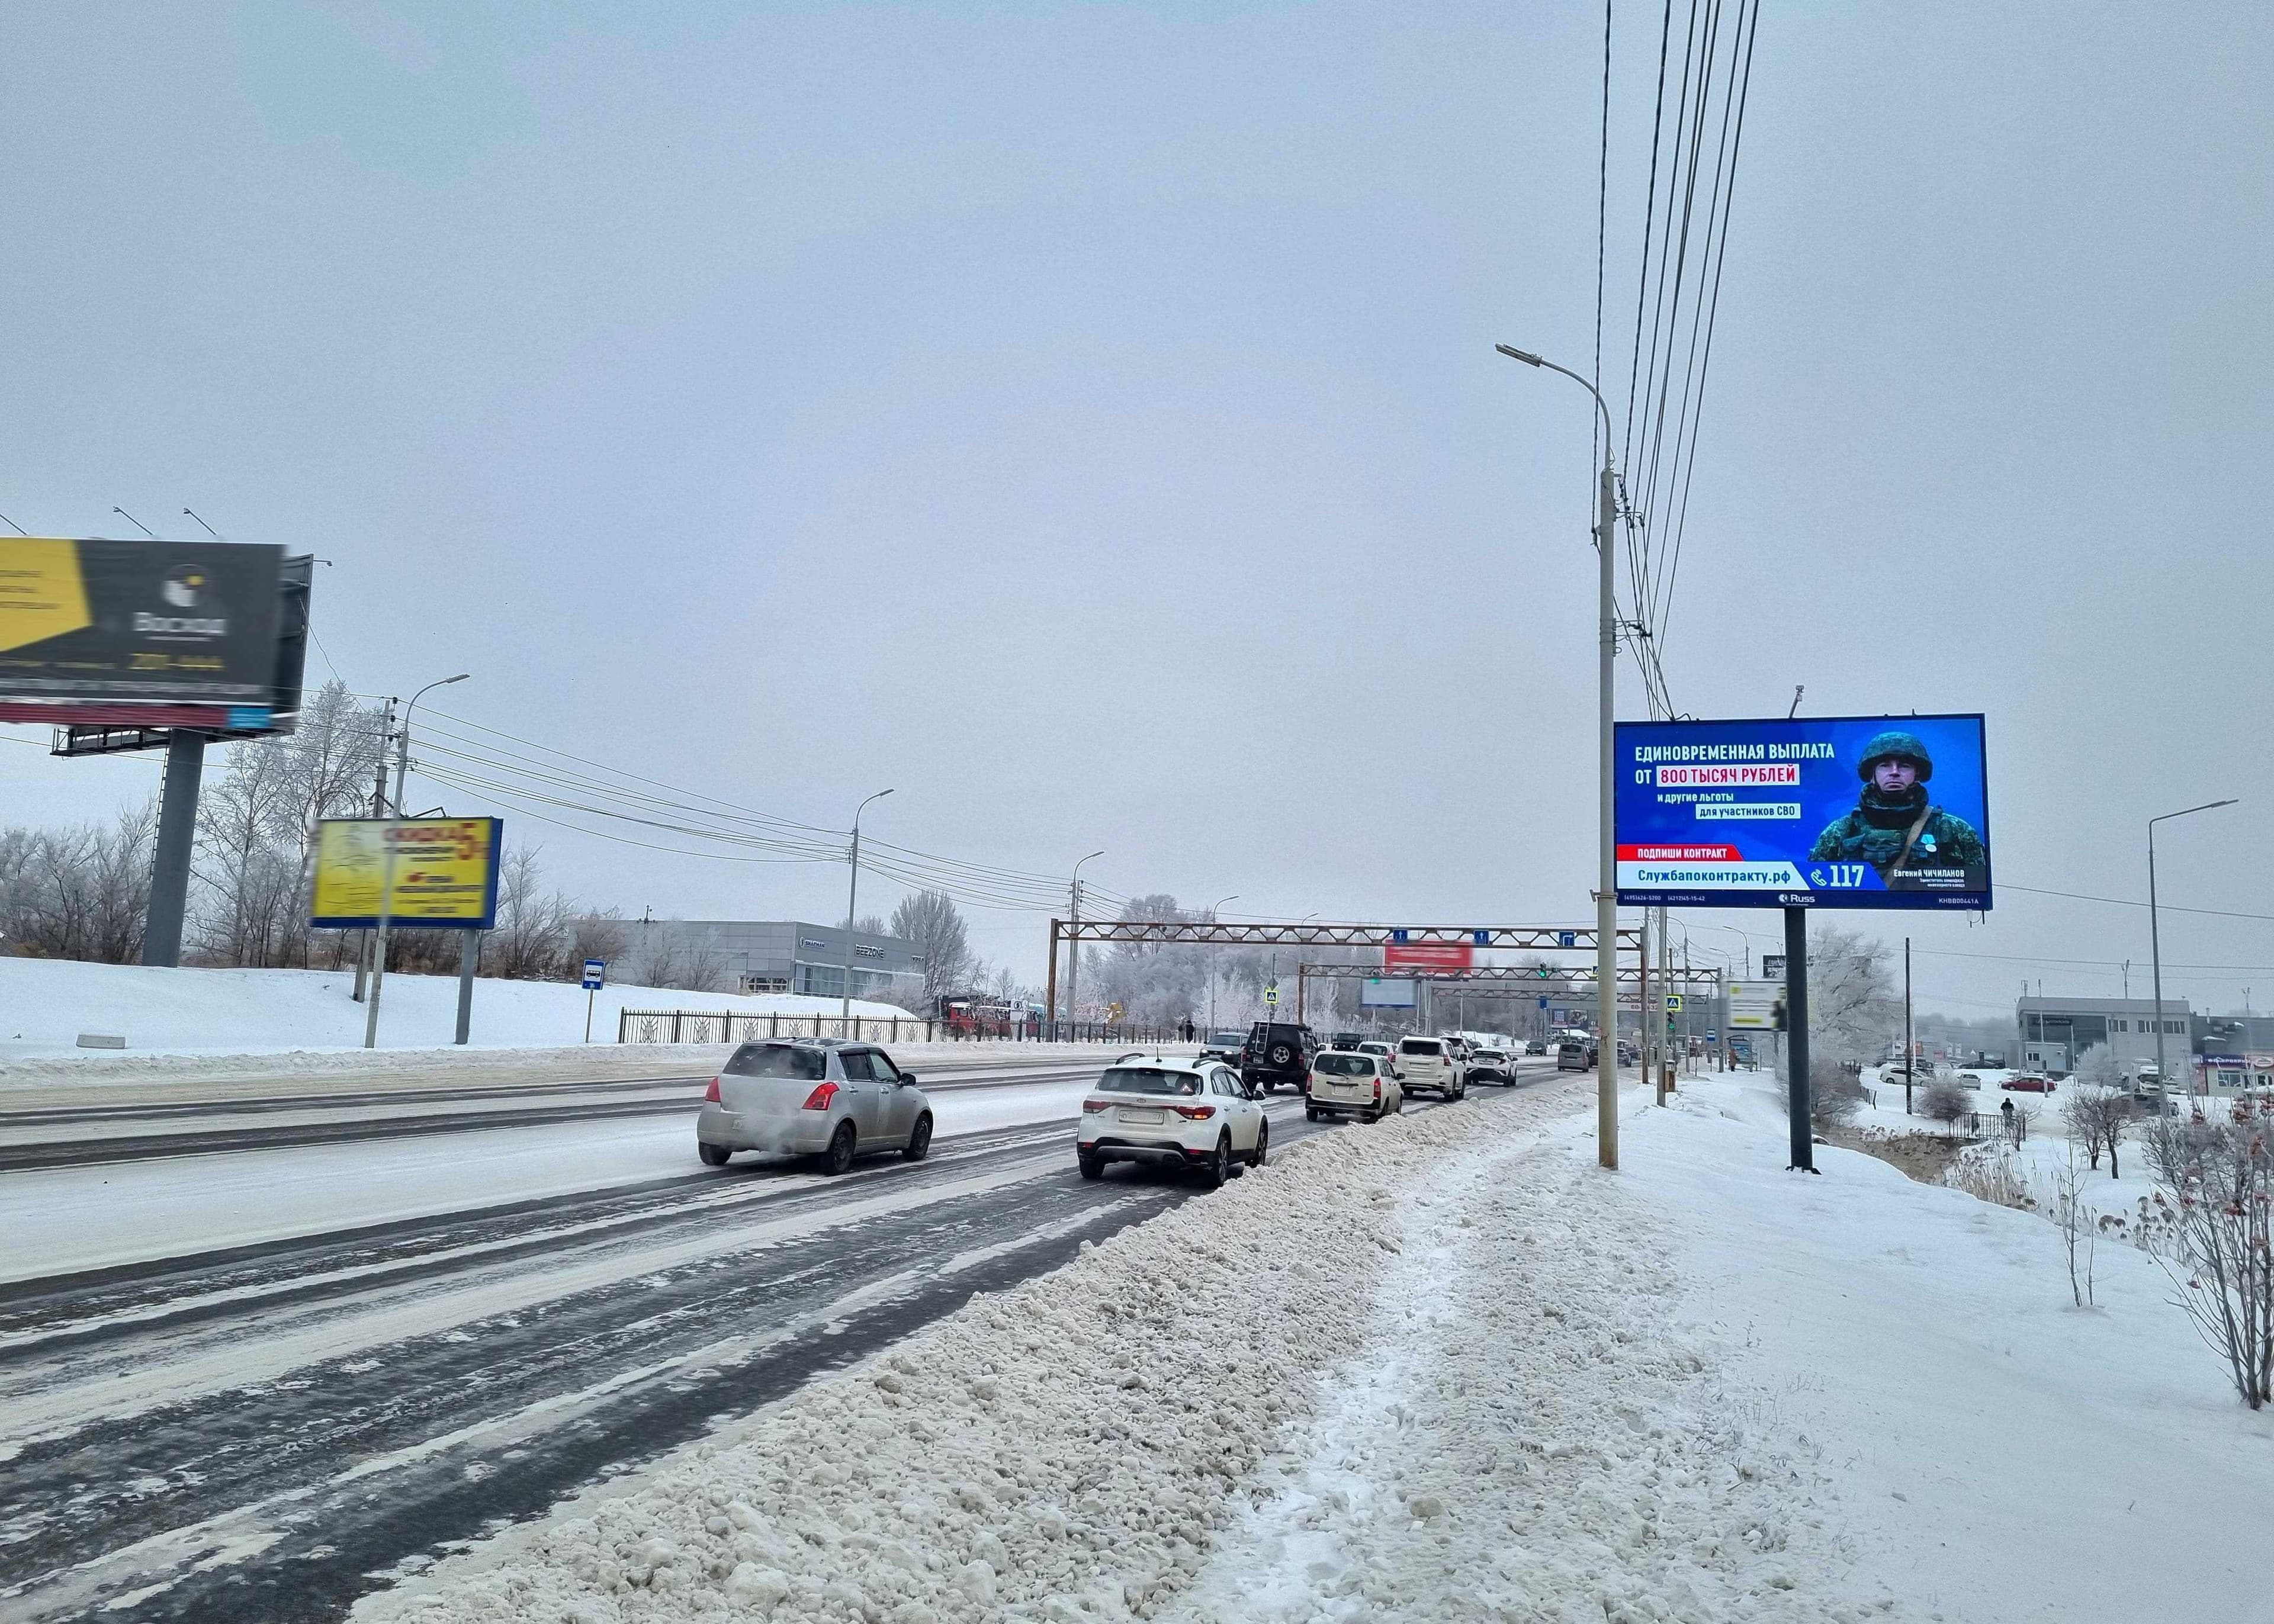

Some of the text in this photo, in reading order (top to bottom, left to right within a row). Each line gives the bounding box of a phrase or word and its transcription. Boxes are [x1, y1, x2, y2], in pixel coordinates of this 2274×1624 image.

[1635, 743, 1835, 763] ЕДИНОВРЕМЕННАЯ ВЫПЛАТА
[1635, 764, 1796, 784] ОТ 800 ТЫСЯЧ РУБЛЕЙ
[1665, 794, 1698, 804] другие
[1700, 793, 1734, 802] льготы
[1700, 806, 1796, 818] для участников СВО
[1637, 848, 1727, 860] ПОДПИШИ КОНТРАКТ
[1638, 869, 1791, 885] Службапоконтракту.рф
[1830, 865, 1864, 887] 117
[1894, 869, 1965, 877] Евгений ЧИЧИЛАНОВ
[1790, 894, 1816, 903] Russ
[855, 944, 885, 959] BEEZONE
